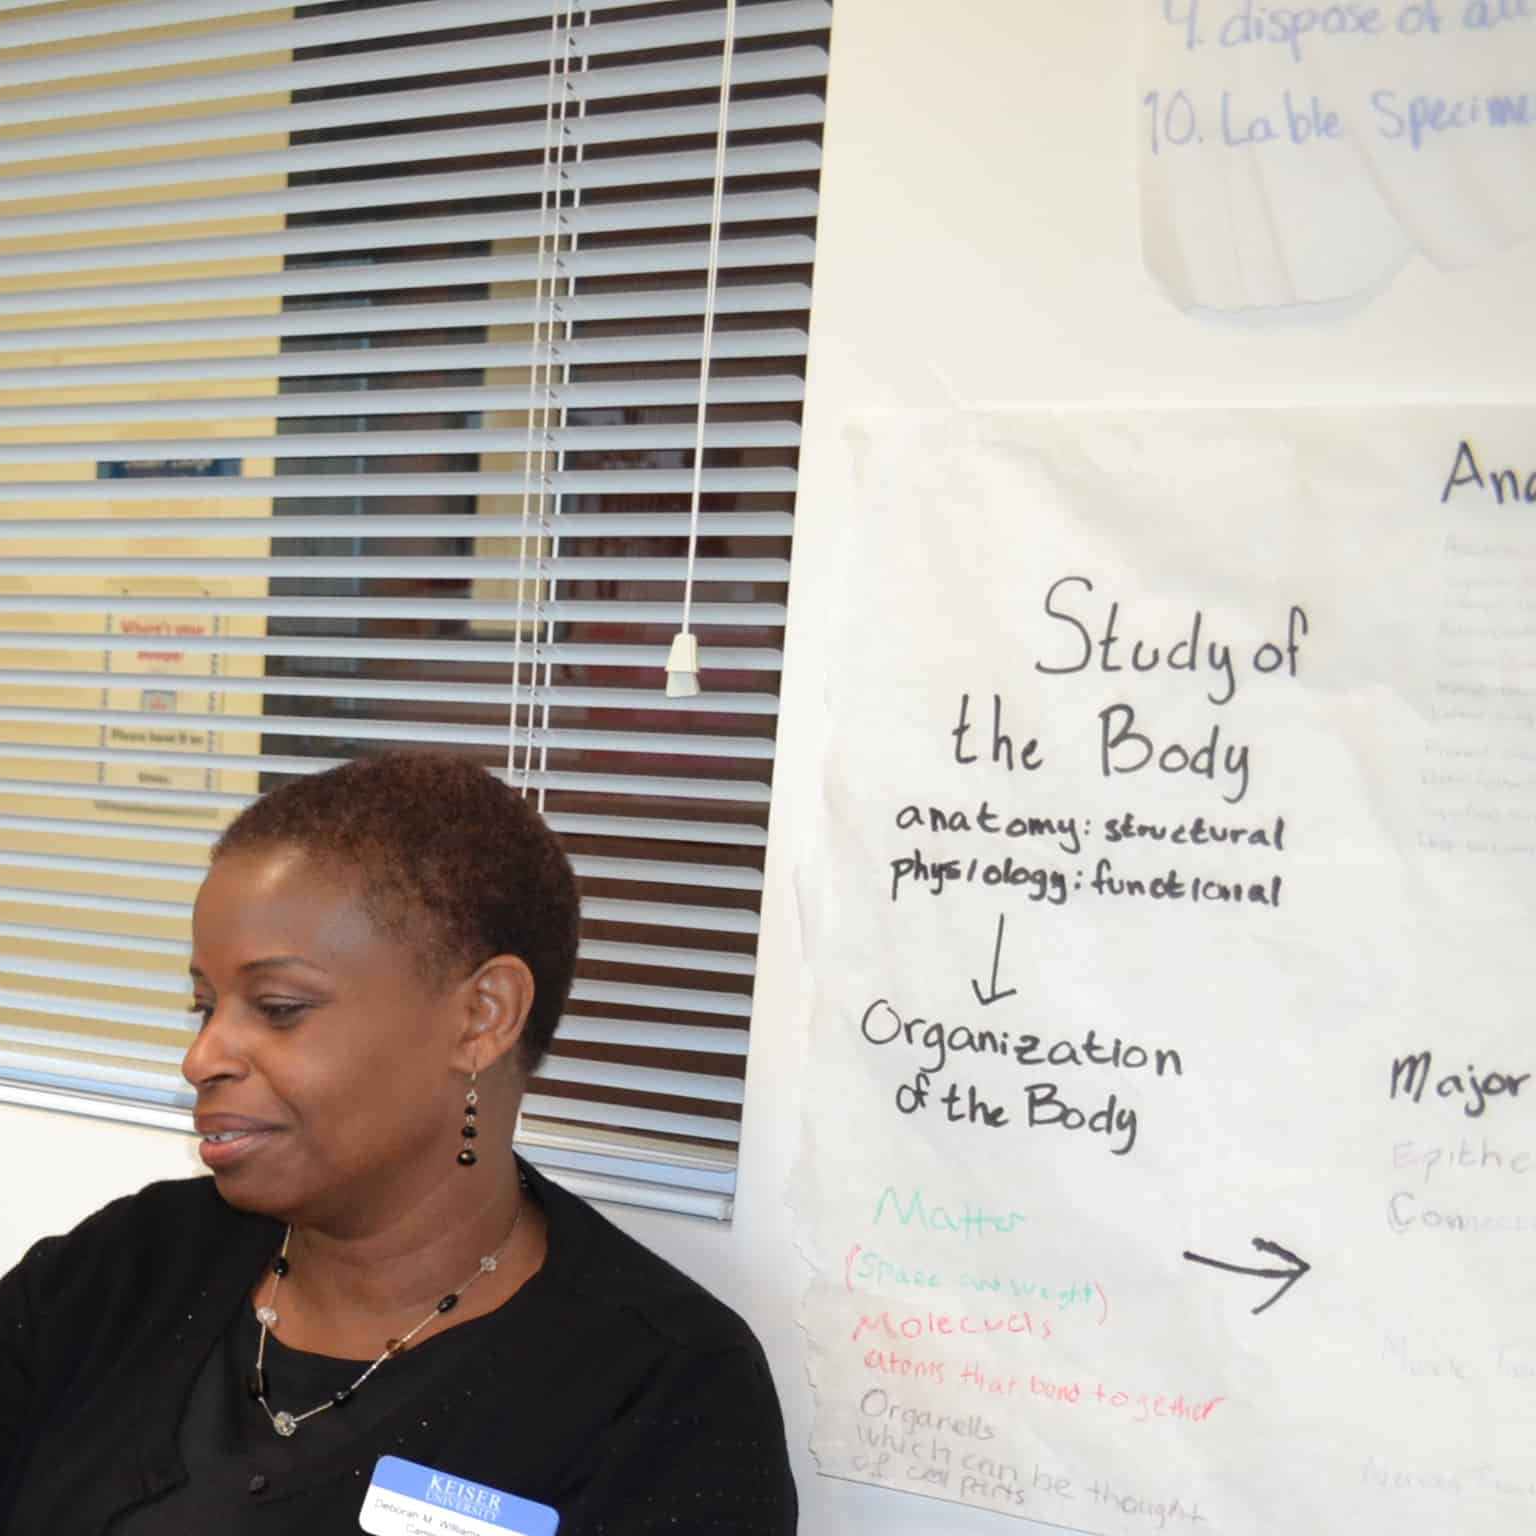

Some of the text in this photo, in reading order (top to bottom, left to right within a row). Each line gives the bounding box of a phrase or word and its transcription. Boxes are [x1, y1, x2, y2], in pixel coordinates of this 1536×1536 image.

[1035, 576, 1309, 704] Study of
[952, 694, 1252, 805] the Body
[1104, 815, 1286, 852] structural
[860, 998, 1184, 1077] Organization
[894, 1071, 1140, 1156] of the Body
[1390, 1050, 1532, 1118] Major
[872, 1185, 1027, 1239] Matter
[425, 1487, 499, 1522] UNIVERSITY
[429, 1473, 502, 1513] KEISER
